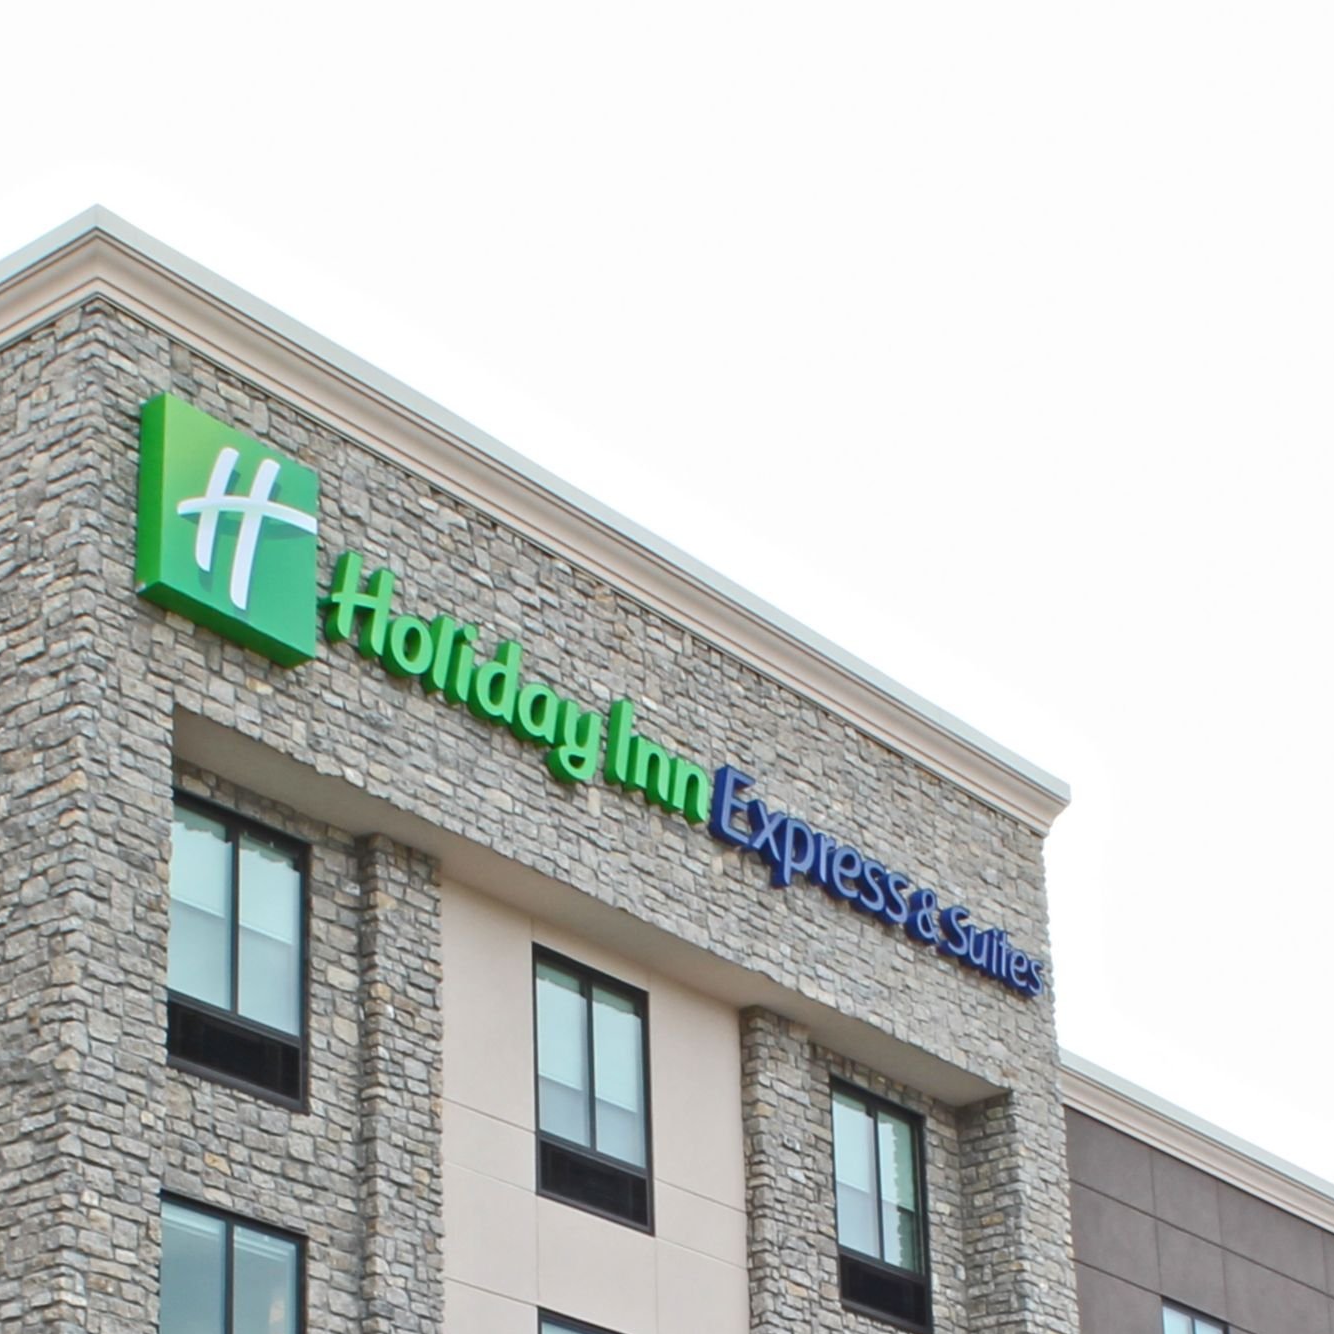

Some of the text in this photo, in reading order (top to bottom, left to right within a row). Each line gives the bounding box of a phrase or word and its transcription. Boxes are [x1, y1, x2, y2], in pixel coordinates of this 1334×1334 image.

[320, 550, 1044, 997] Holiday Inn Express & Suites
